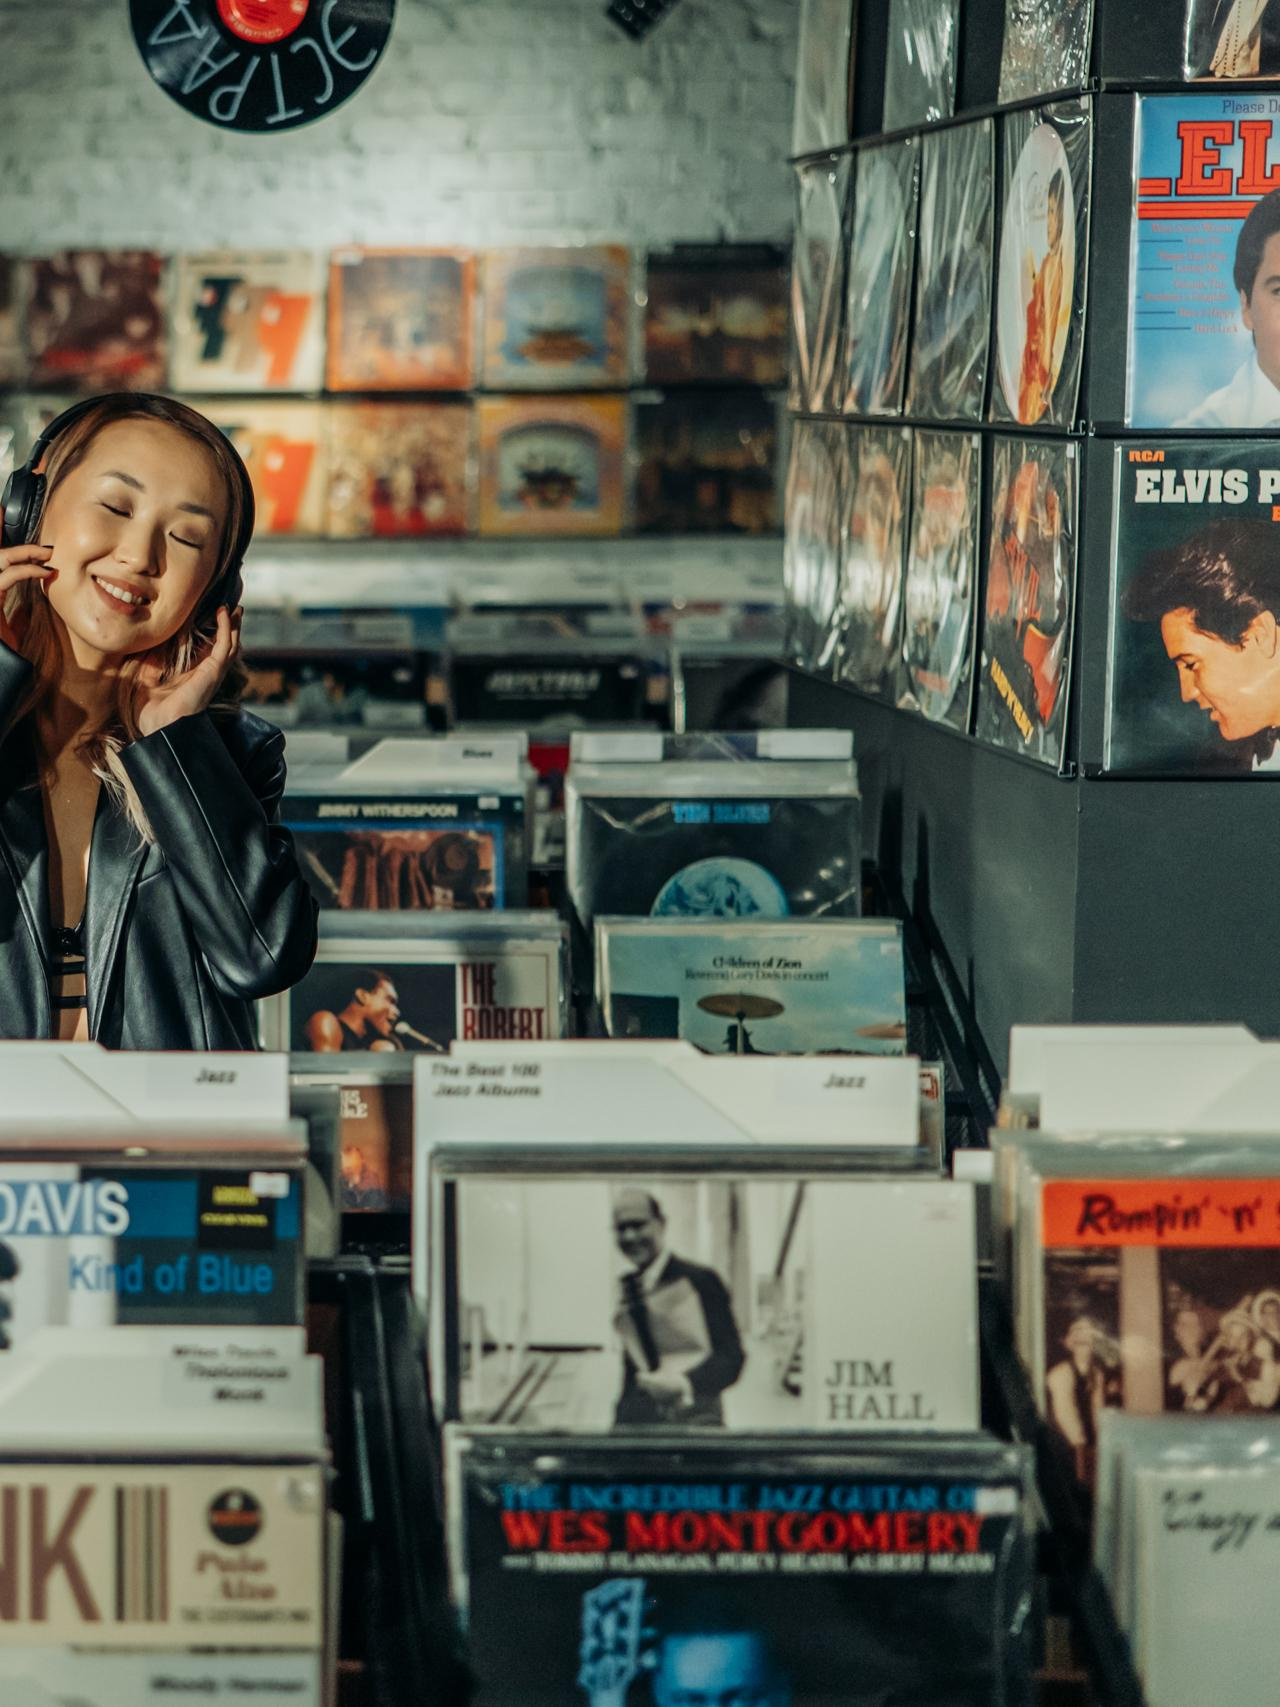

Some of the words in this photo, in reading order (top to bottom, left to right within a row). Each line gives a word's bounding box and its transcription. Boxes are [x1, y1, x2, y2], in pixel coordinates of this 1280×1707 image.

[1222, 99, 1265, 114] Please
[1129, 450, 1165, 463] RCA
[1135, 469, 1249, 504] ELVIS
[776, 956, 802, 969] Zion
[460, 962, 496, 1005] THE
[195, 1068, 239, 1086] Jazz
[431, 1062, 462, 1078] The
[467, 1062, 506, 1079] Best
[510, 1062, 541, 1079] 100
[822, 1072, 868, 1090] Jazz
[433, 1083, 472, 1098] Jazz
[476, 1083, 542, 1098] Albums
[68, 1254, 145, 1293] Kind
[153, 1254, 192, 1294] of
[198, 1255, 275, 1294] Blue
[825, 1359, 894, 1389] JIM
[826, 1393, 938, 1422] HALL
[757, 1485, 824, 1511] JAZZ
[830, 1485, 940, 1511] GUITAR
[946, 1485, 976, 1511] O
[500, 1511, 612, 1552] WES
[626, 1511, 985, 1554] MONTGOMERY
